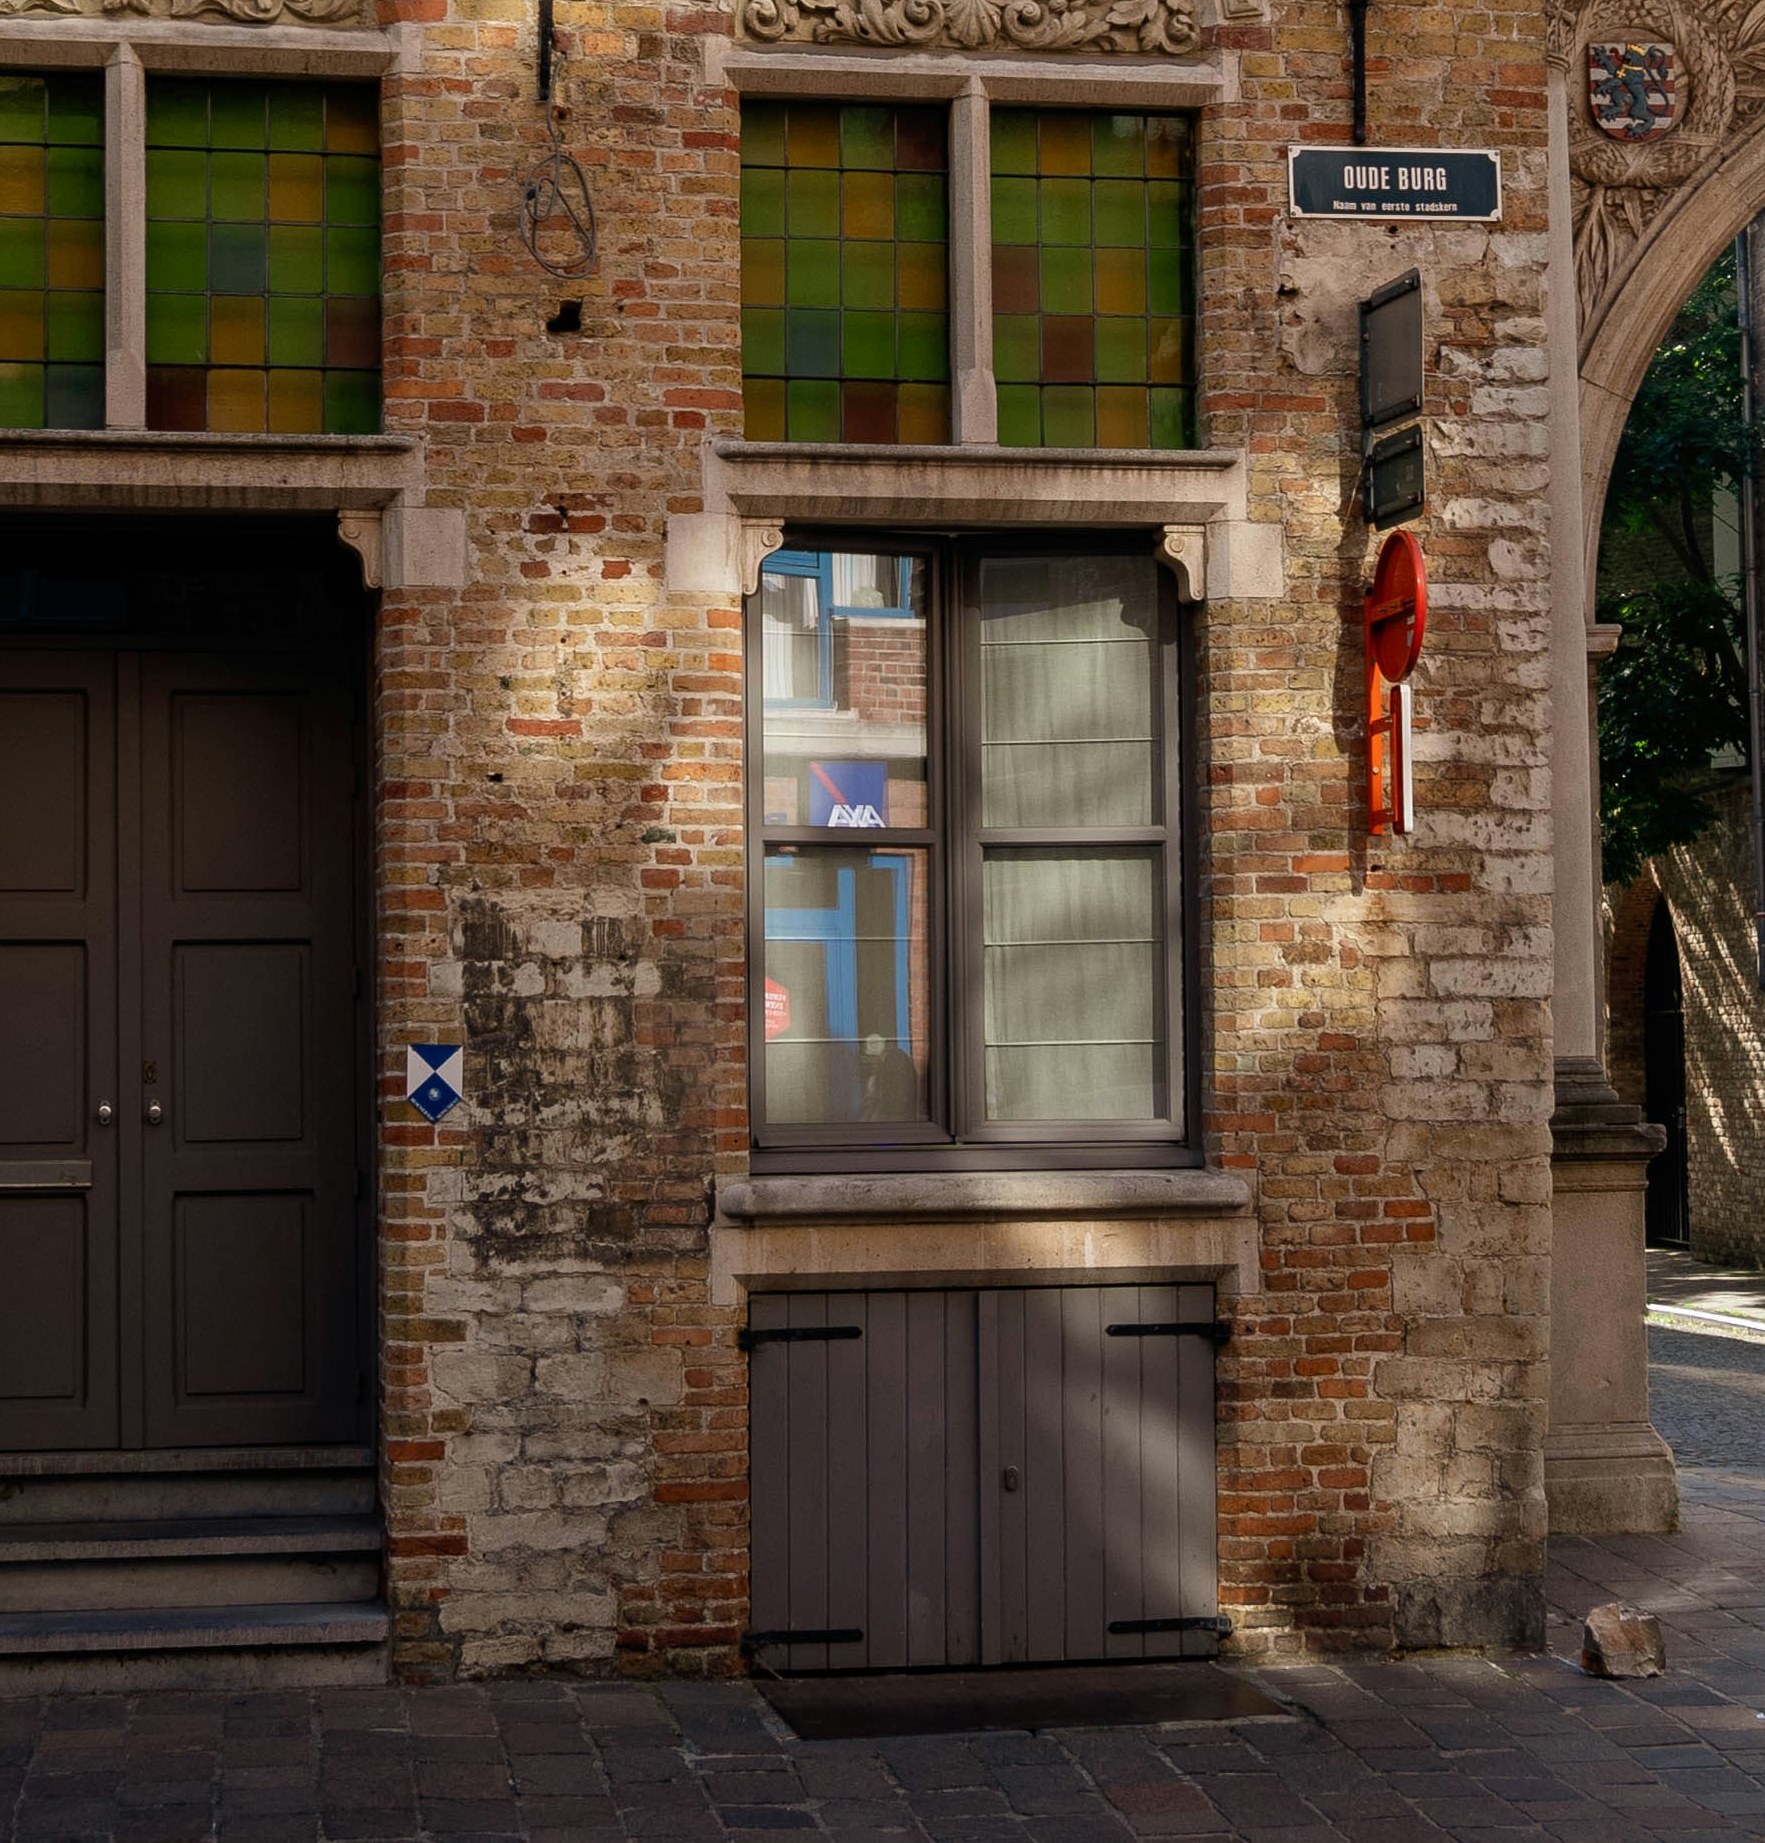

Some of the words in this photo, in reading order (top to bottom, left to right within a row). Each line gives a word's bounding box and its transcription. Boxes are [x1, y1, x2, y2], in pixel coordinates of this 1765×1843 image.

[1343, 165, 1391, 190] OUDE
[1398, 166, 1447, 191] BURG
[1332, 200, 1357, 211] Naam
[1361, 202, 1377, 211] van
[1381, 201, 1410, 212] eerste
[1415, 202, 1458, 212] stadskern
